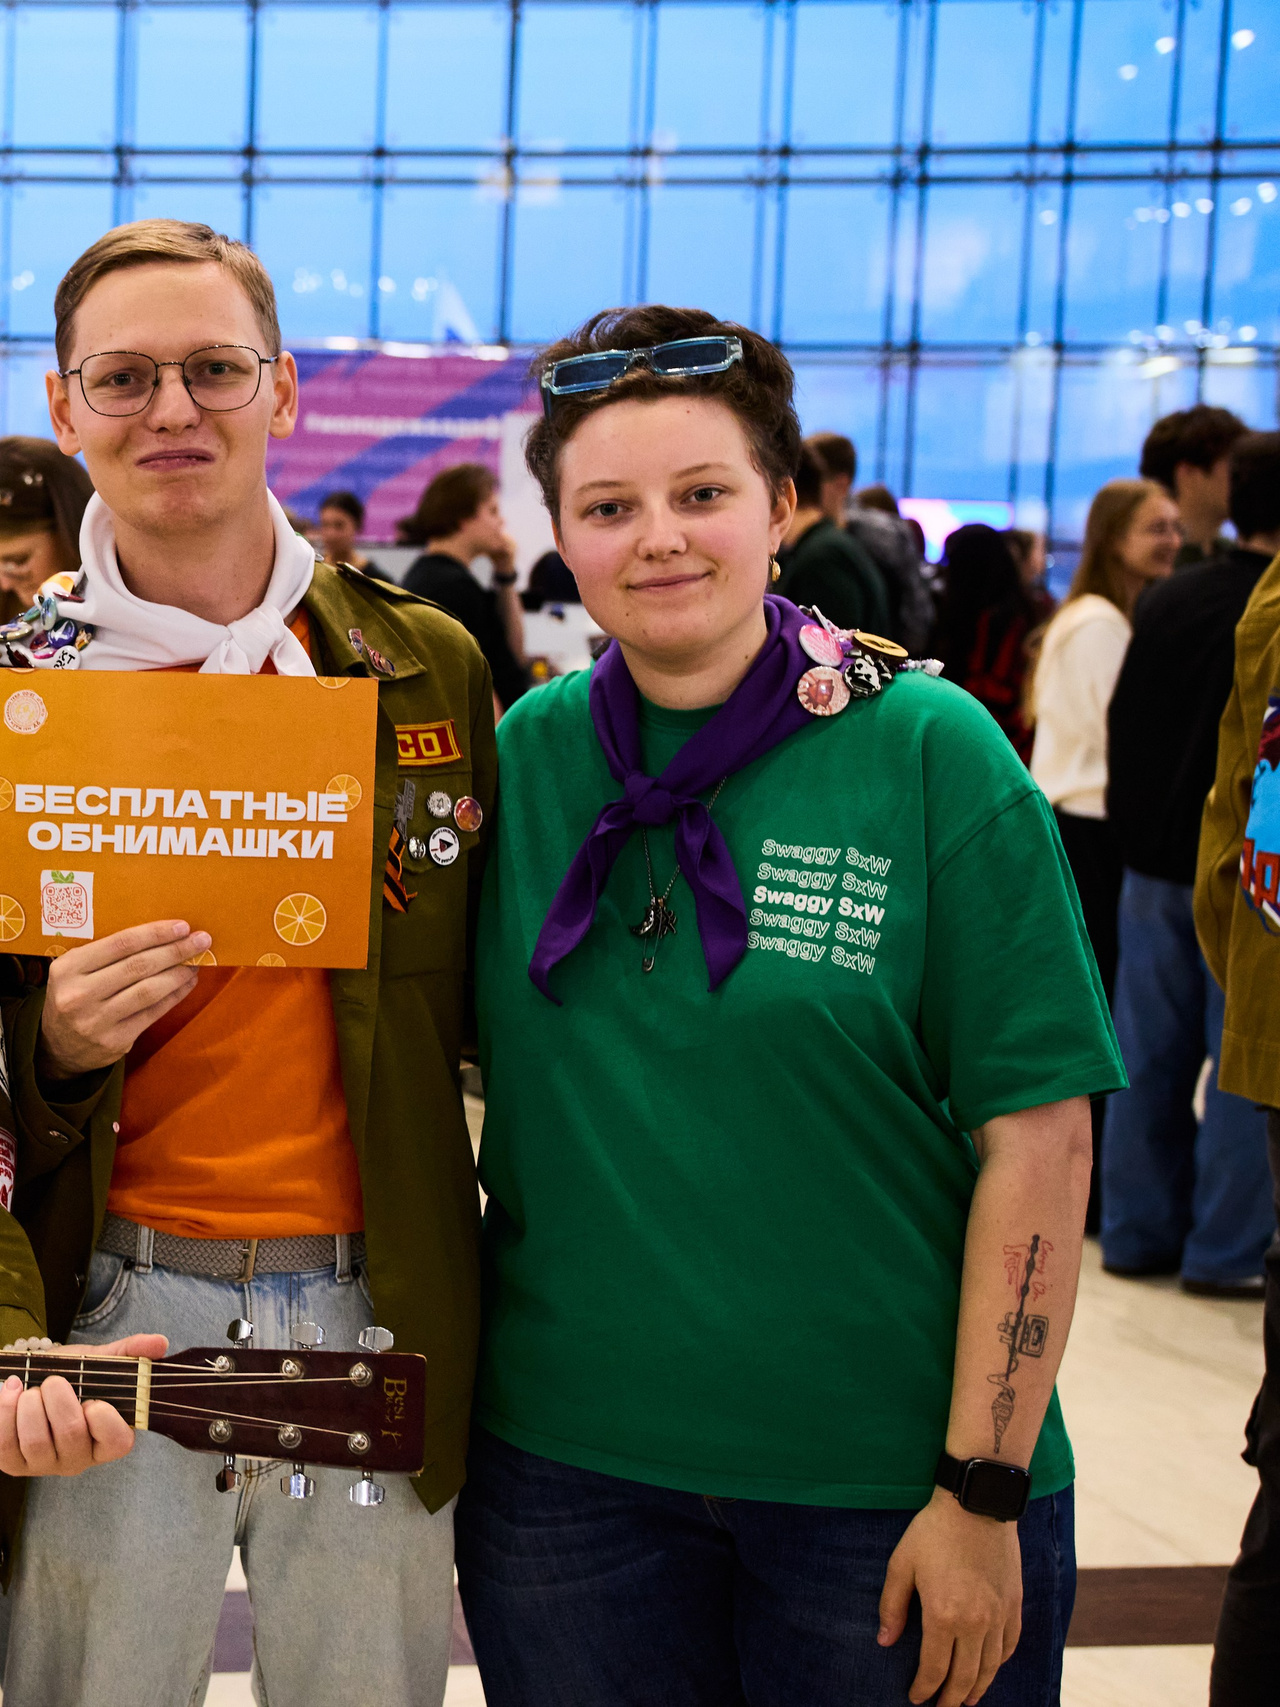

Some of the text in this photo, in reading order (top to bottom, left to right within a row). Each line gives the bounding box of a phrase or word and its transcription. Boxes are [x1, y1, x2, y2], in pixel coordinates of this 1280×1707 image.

[15, 783, 348, 823] БЕСПЛАТНЫЕ
[28, 821, 334, 859] ОБНИМАШКИ
[761, 838, 892, 877] Swaggy SxW
[757, 862, 888, 901] Swaggy SxW
[753, 885, 885, 925] Swaggy SxW
[749, 908, 881, 950] Swaggy SxW
[747, 931, 876, 975] Swaggy SxW
